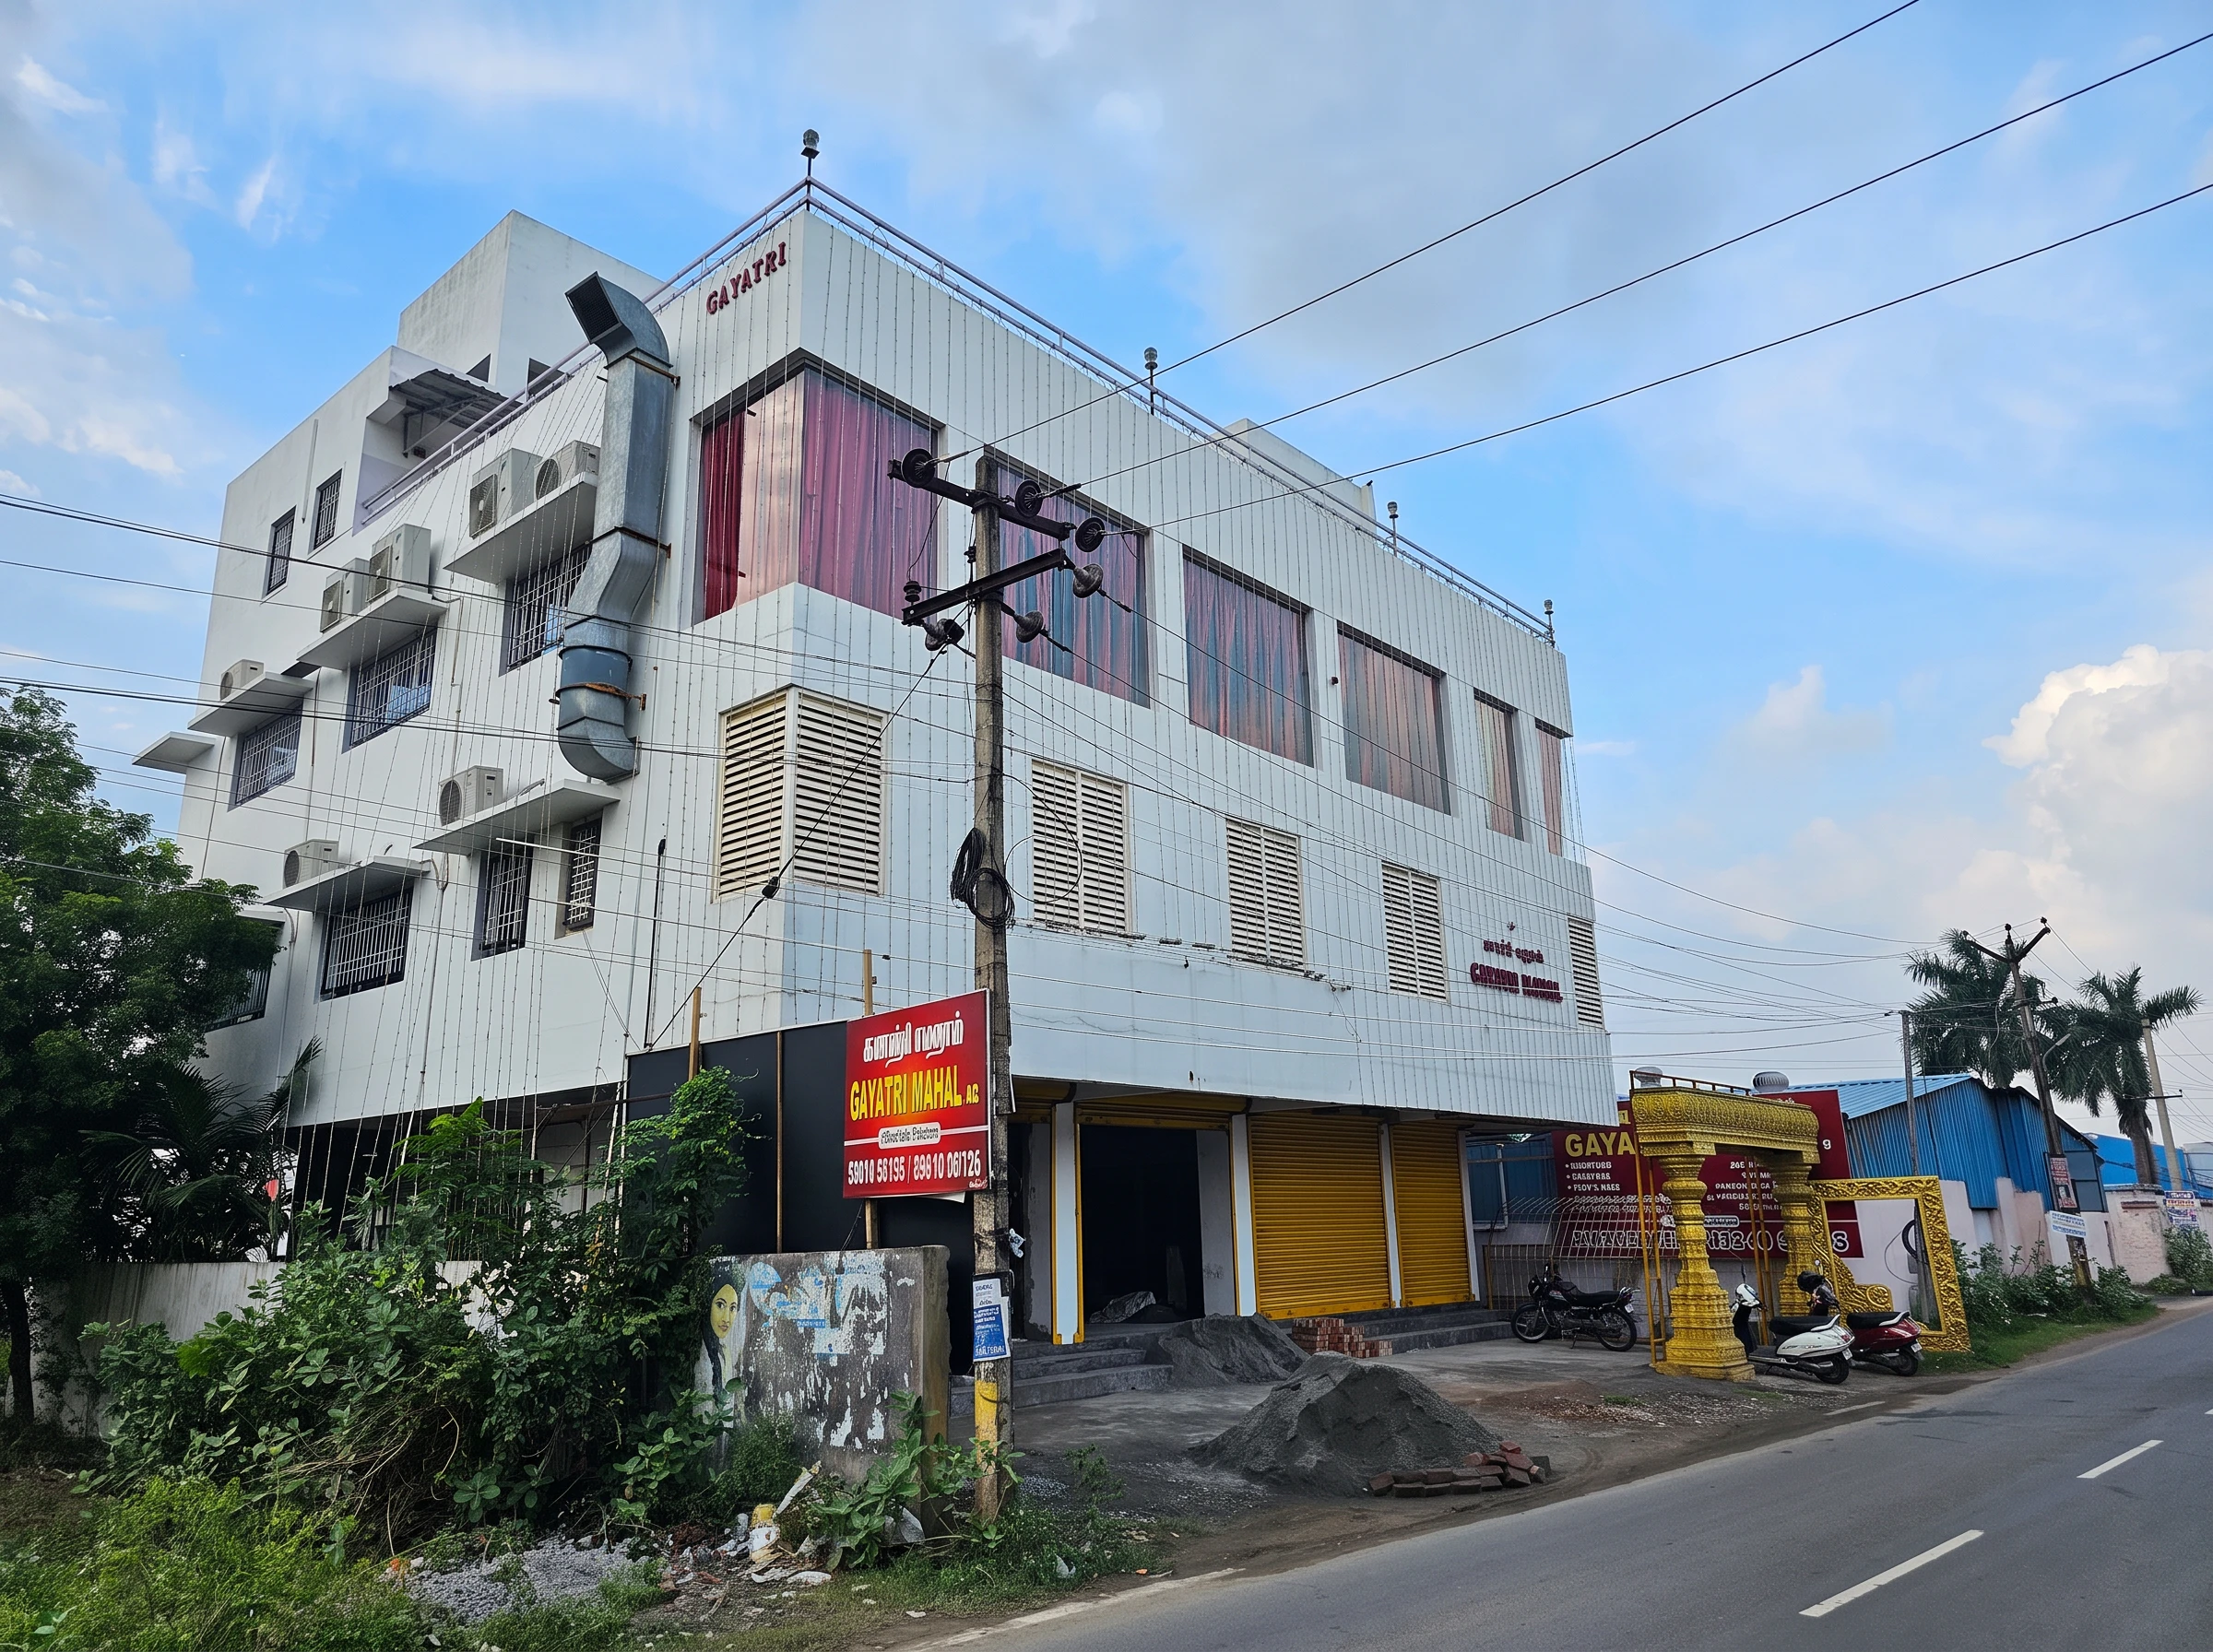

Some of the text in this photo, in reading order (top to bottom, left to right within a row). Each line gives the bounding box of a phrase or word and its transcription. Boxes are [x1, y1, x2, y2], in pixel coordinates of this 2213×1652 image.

[705, 242, 787, 314] GAYATRI
[850, 1073, 907, 1121] GAYATRI
[911, 1065, 962, 1113] MAHAL
